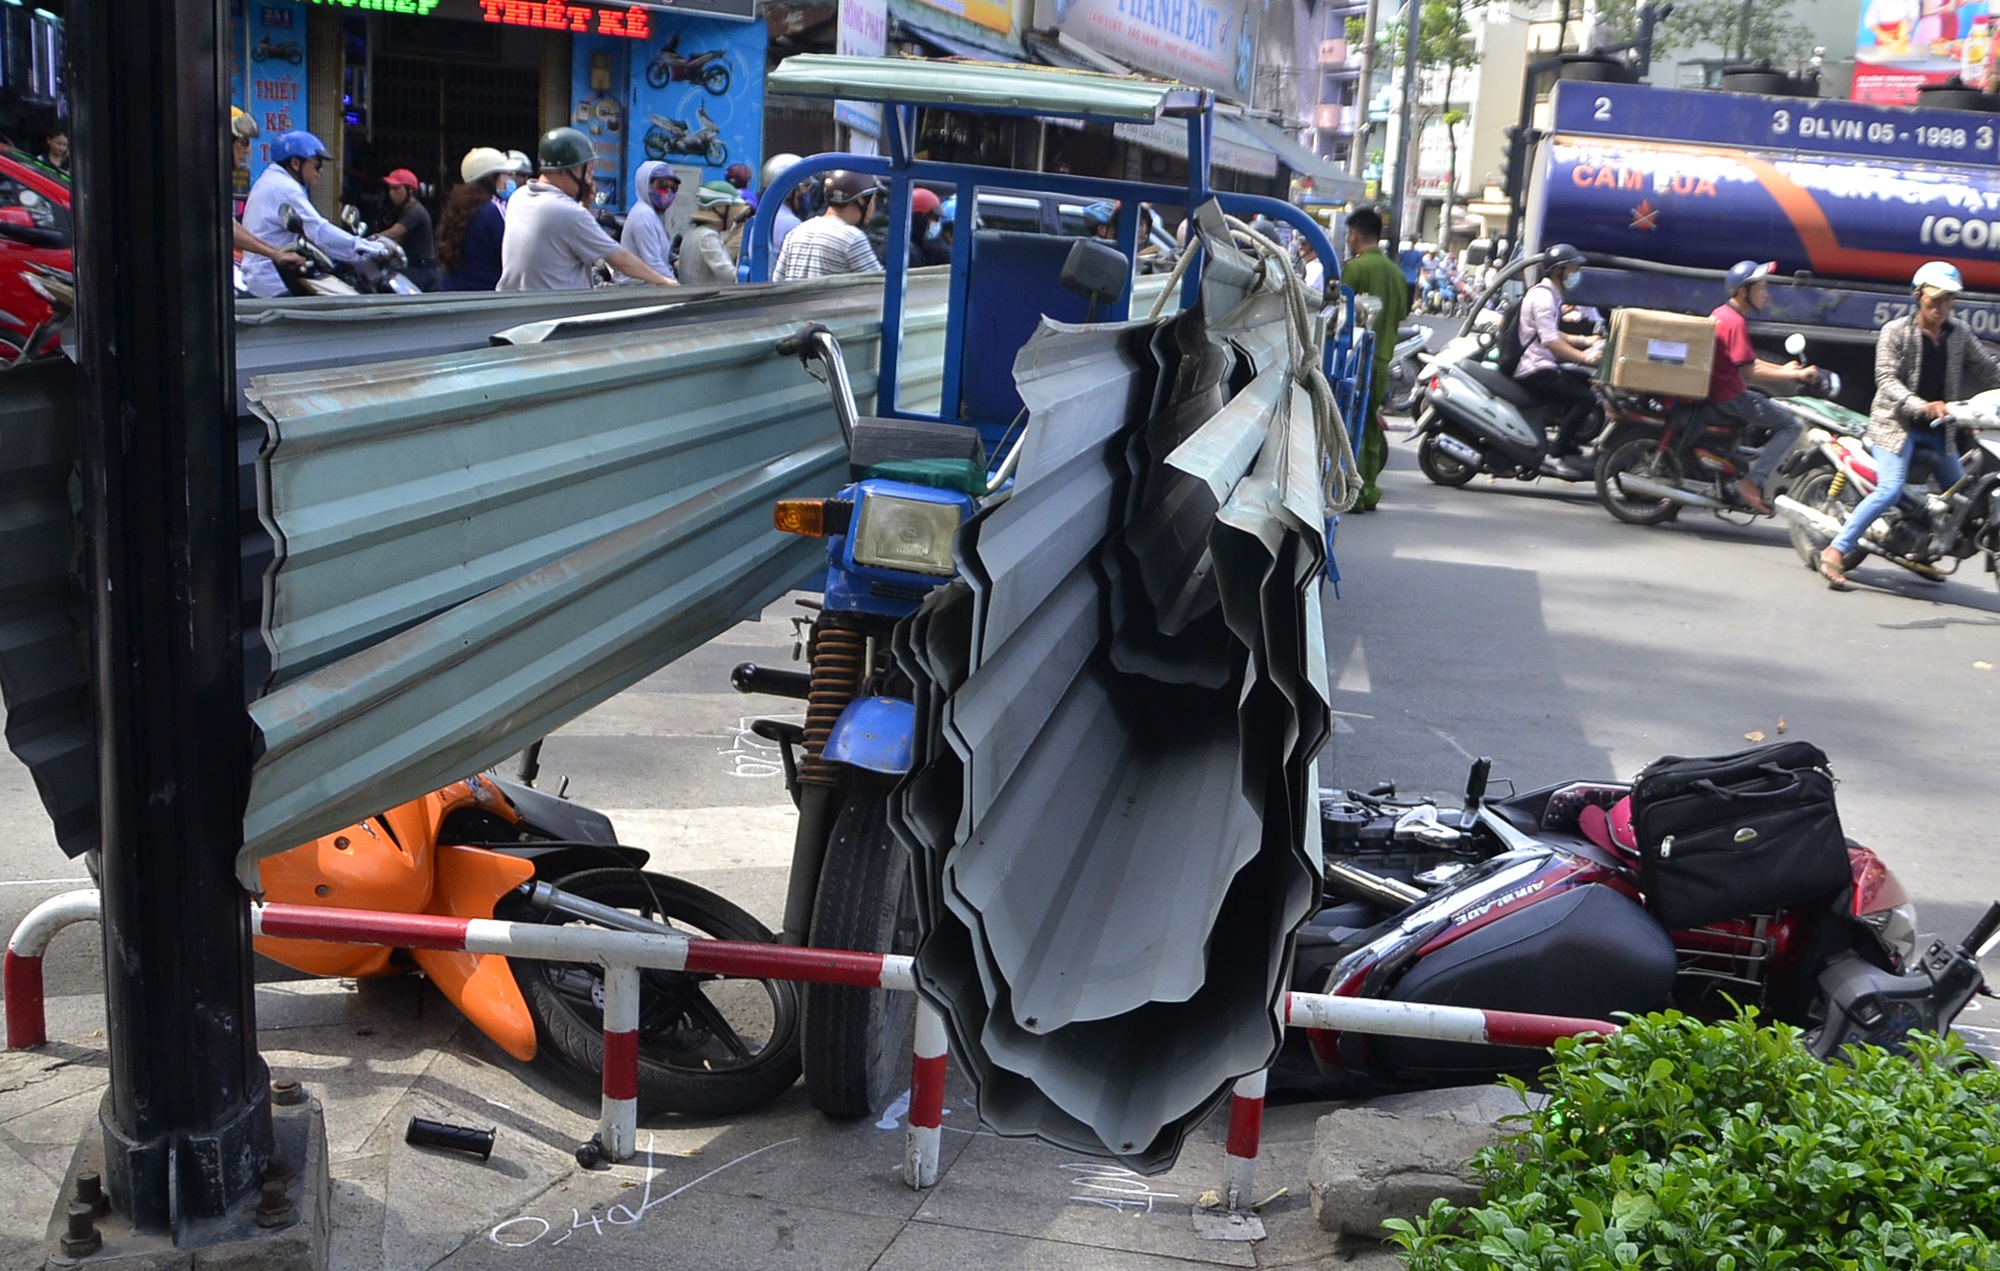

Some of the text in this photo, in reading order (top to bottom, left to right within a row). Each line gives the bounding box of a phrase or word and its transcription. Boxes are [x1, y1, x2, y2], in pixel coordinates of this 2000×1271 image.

[1593, 96, 1613, 122] 2
[1771, 109, 1791, 135] 3
[1798, 116, 1864, 141] ĐLVN
[1867, 122, 1896, 144] 05
[1914, 125, 1968, 149] 1998
[1974, 125, 1995, 151] 3
